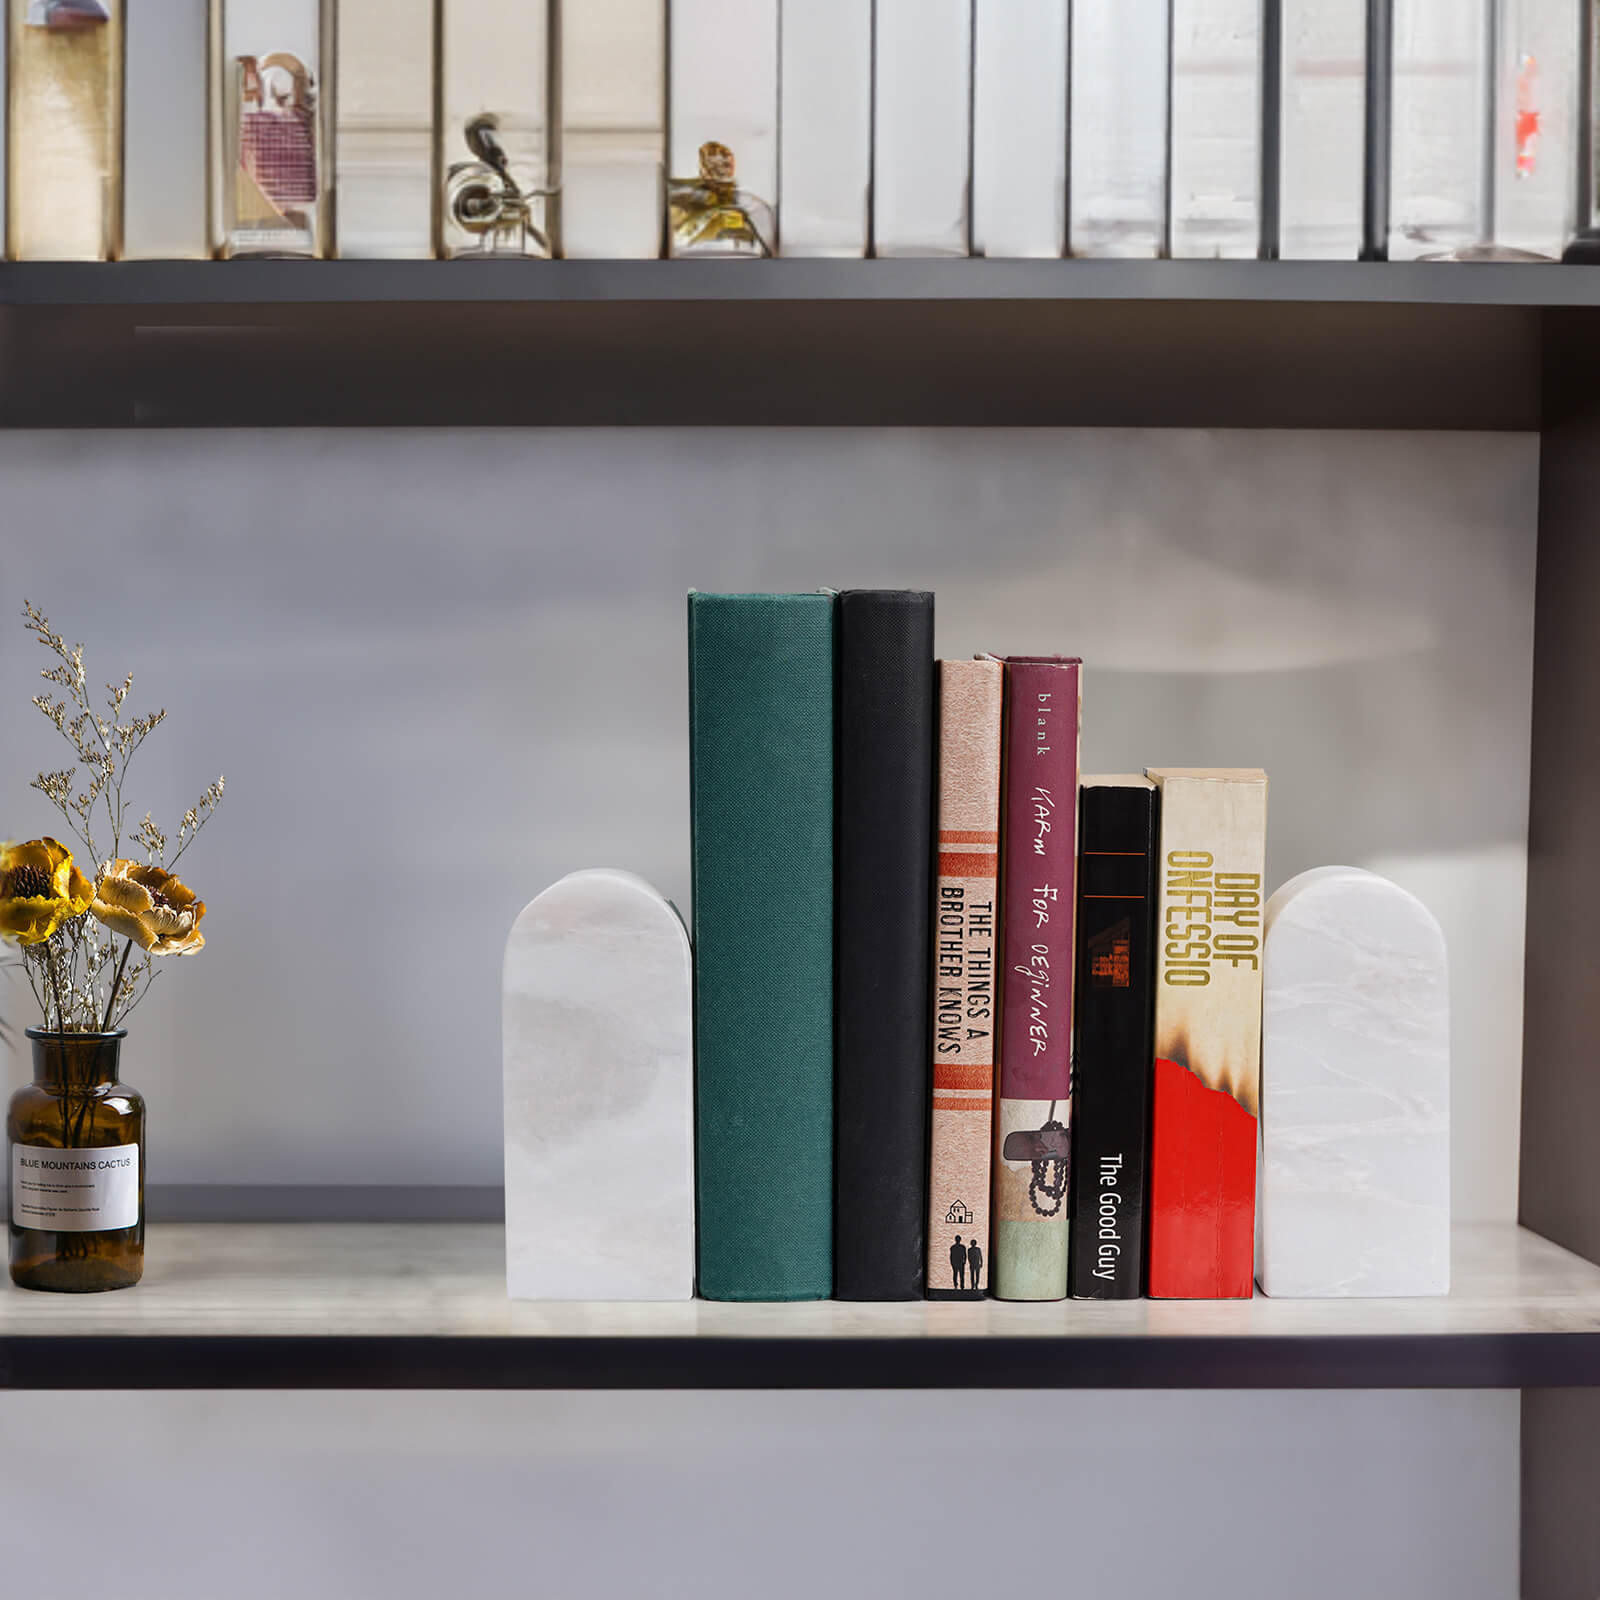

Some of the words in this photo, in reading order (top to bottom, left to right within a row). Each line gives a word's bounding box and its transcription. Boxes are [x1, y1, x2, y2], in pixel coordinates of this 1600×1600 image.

[1037, 693, 1051, 755] blank
[969, 901, 992, 937] THE
[1032, 884, 1058, 929] FOR
[1164, 850, 1214, 986] ONFESSIO
[1213, 873, 1260, 928] DAY
[939, 887, 964, 977] BROTHER
[1212, 934, 1259, 970] OF
[967, 947, 991, 1018] THINGS
[938, 987, 962, 1053] KNOWS
[967, 1028, 989, 1040] A
[20, 1158, 40, 1169] BLUE
[41, 1161, 96, 1170] MOUNTAINS
[98, 1157, 130, 1169] CACTUS
[1100, 1153, 1122, 1186] The
[1099, 1193, 1121, 1239] Good
[1092, 1244, 1120, 1280] Guy
